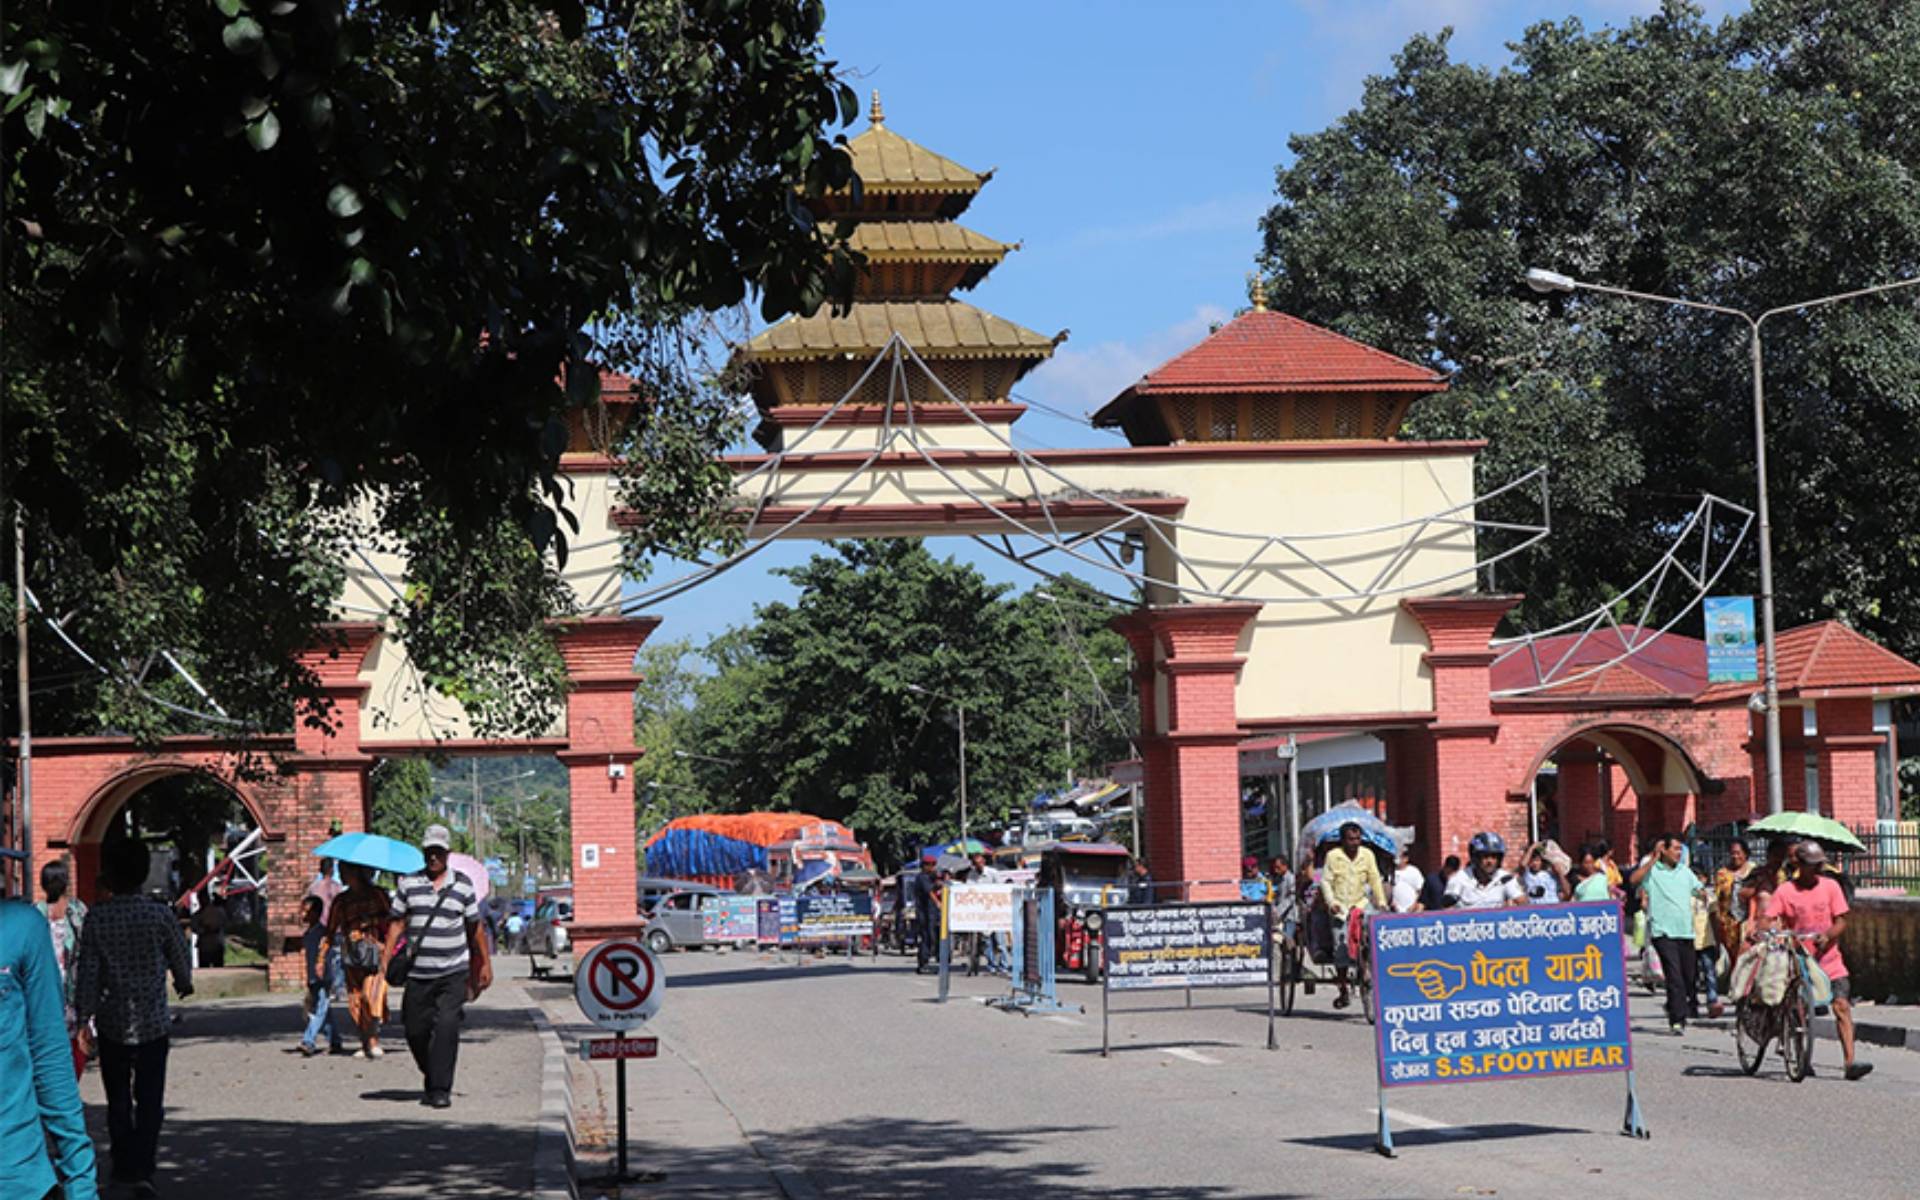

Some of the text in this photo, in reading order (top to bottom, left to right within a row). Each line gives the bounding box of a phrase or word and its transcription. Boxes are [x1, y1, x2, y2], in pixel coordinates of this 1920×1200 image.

[1447, 918, 1495, 943] कार्यालय
[1578, 910, 1617, 939] अनुरोध
[1470, 944, 1603, 987] पैदल यात्री
[1384, 1004, 1442, 1028] कृपया
[1448, 999, 1501, 1020] सडक
[1390, 1029, 1429, 1056] दिनु
[1473, 1020, 1543, 1050] अनुरोध
[1435, 1046, 1624, 1077] S.S.FOOTWEAR
